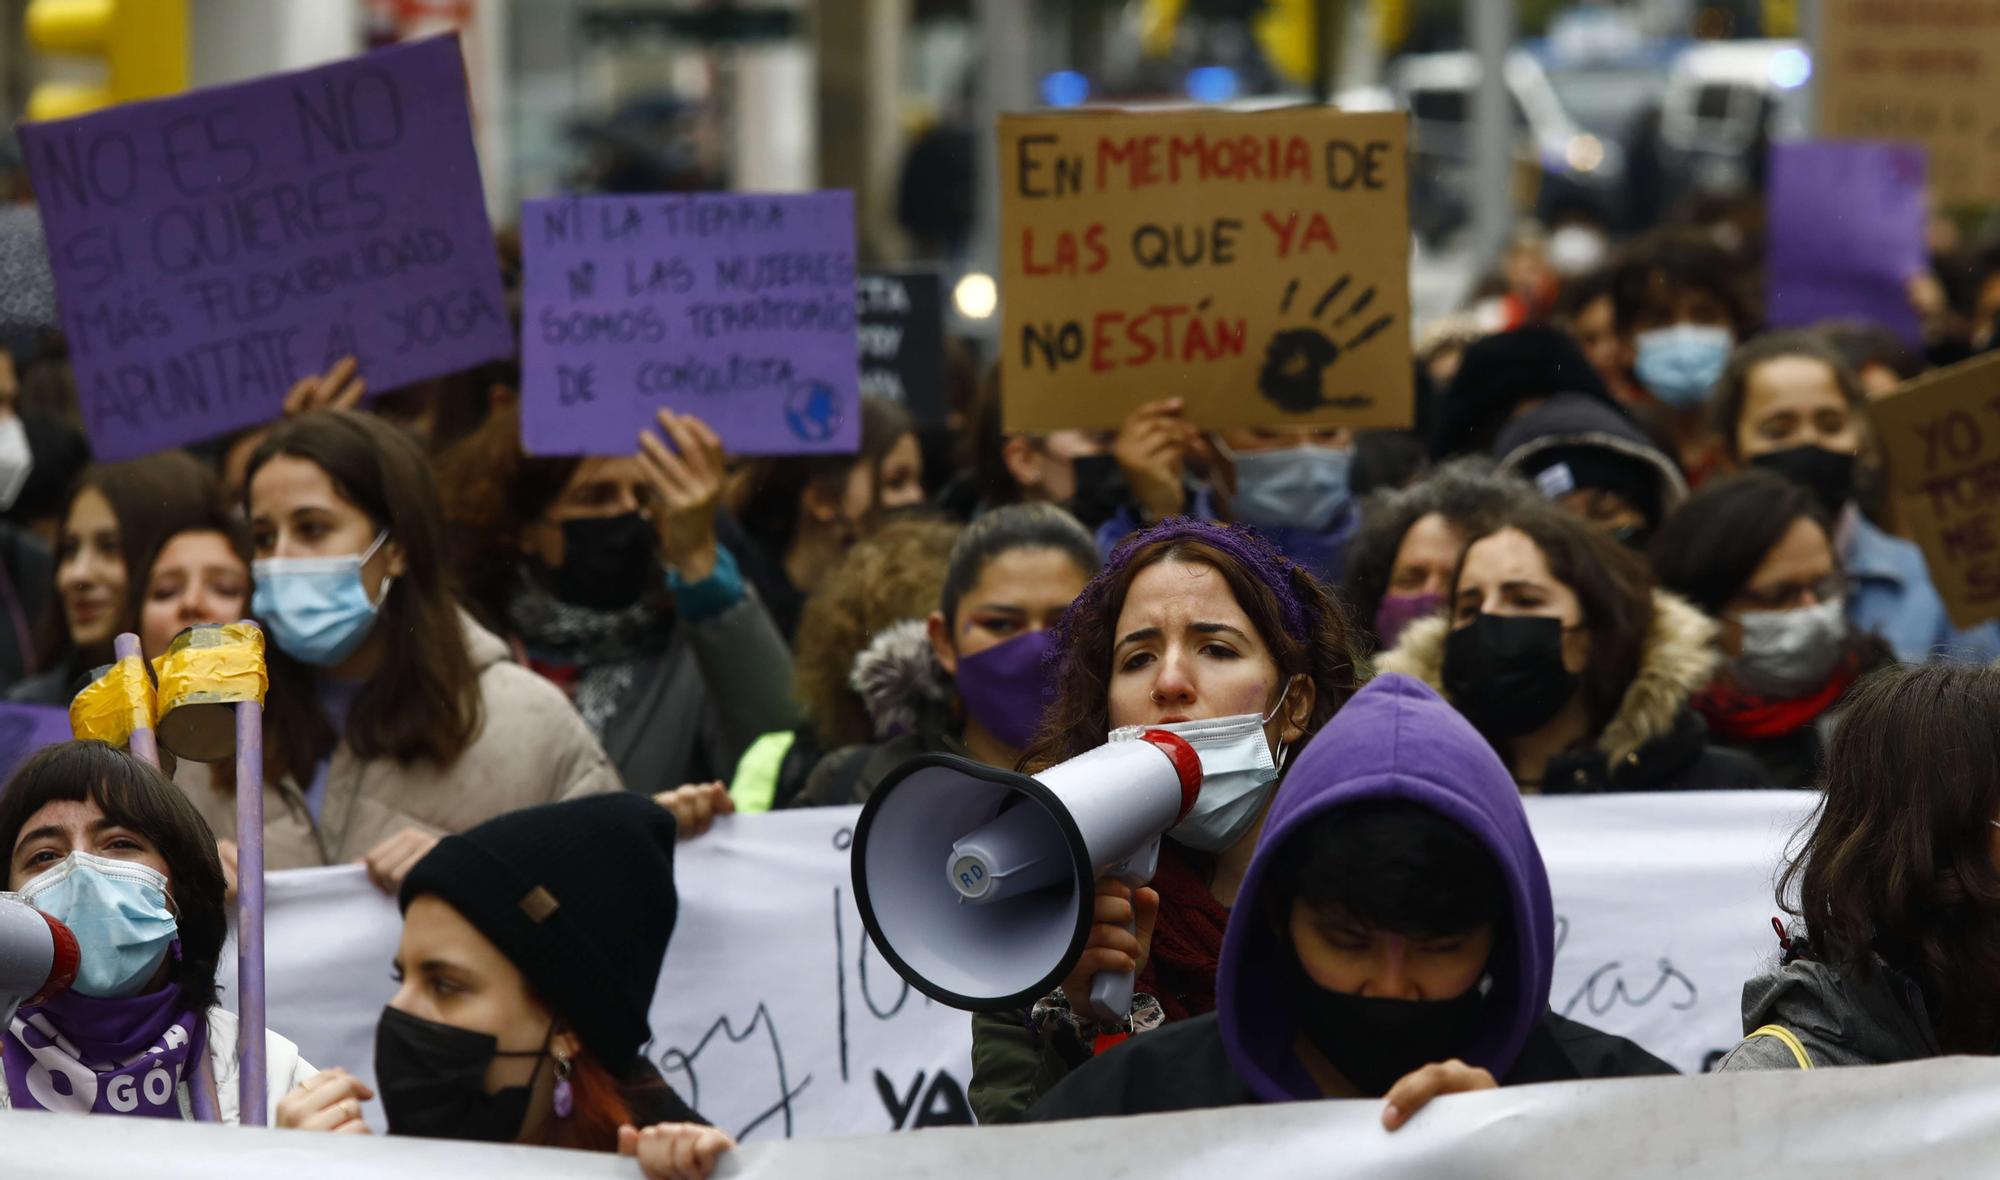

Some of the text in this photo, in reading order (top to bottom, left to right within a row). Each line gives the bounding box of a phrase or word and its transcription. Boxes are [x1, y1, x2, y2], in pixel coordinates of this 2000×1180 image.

[40, 66, 405, 208] NO ES NO
[1015, 133, 1391, 198] EN MEMORIA DE
[544, 196, 784, 249] NI LA TIERRA
[1020, 210, 1339, 276] LAS QUE YA
[62, 223, 124, 292] SI
[182, 228, 454, 327] FLEXIBILIDAD
[624, 255, 696, 296] LAS
[715, 251, 853, 293] MUJERES
[384, 286, 498, 353] YOGA
[539, 295, 853, 346] SOMOS TERRITORIO
[1019, 297, 1247, 374] NO ESTÁN
[556, 354, 795, 407] DE CONQUISTA
